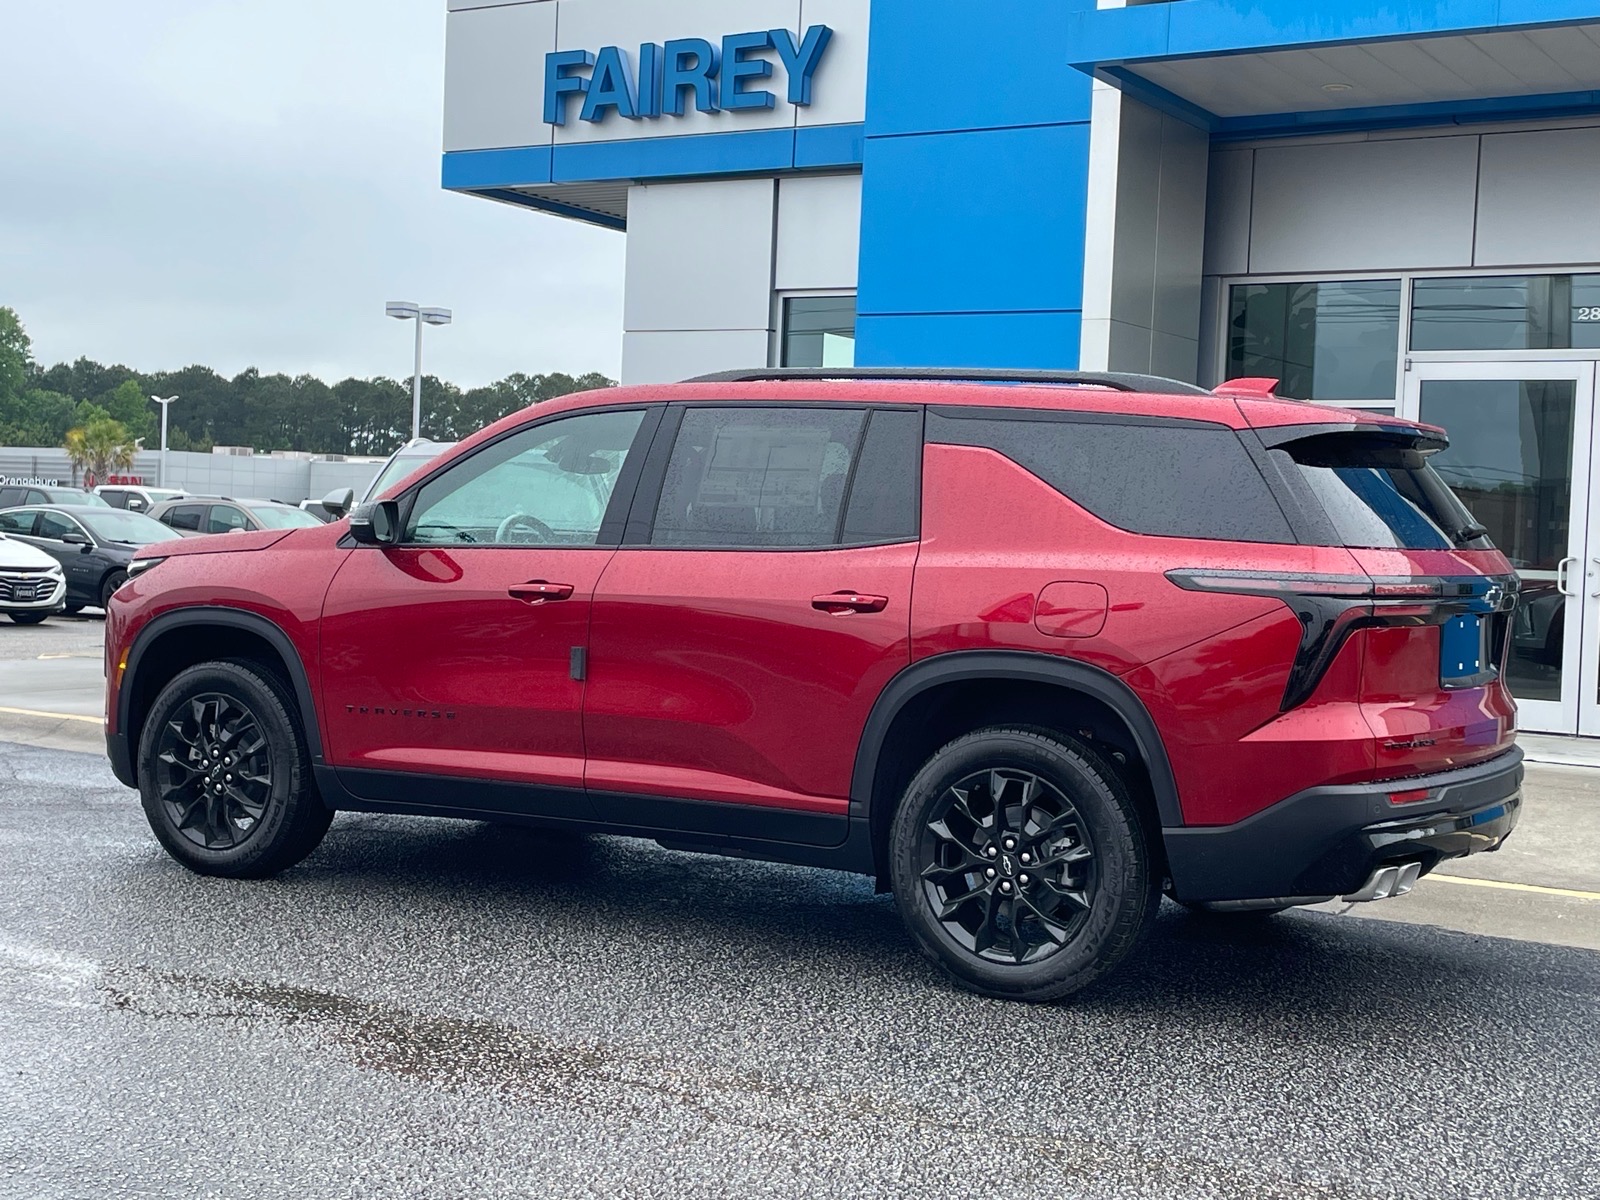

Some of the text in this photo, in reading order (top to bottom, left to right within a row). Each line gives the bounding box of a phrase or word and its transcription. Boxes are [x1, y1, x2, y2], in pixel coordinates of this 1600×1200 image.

[543, 24, 834, 126] FAIREY
[1578, 307, 1600, 320] 28
[83, 473, 143, 487] NSAN
[345, 705, 456, 719] TRAVERSE
